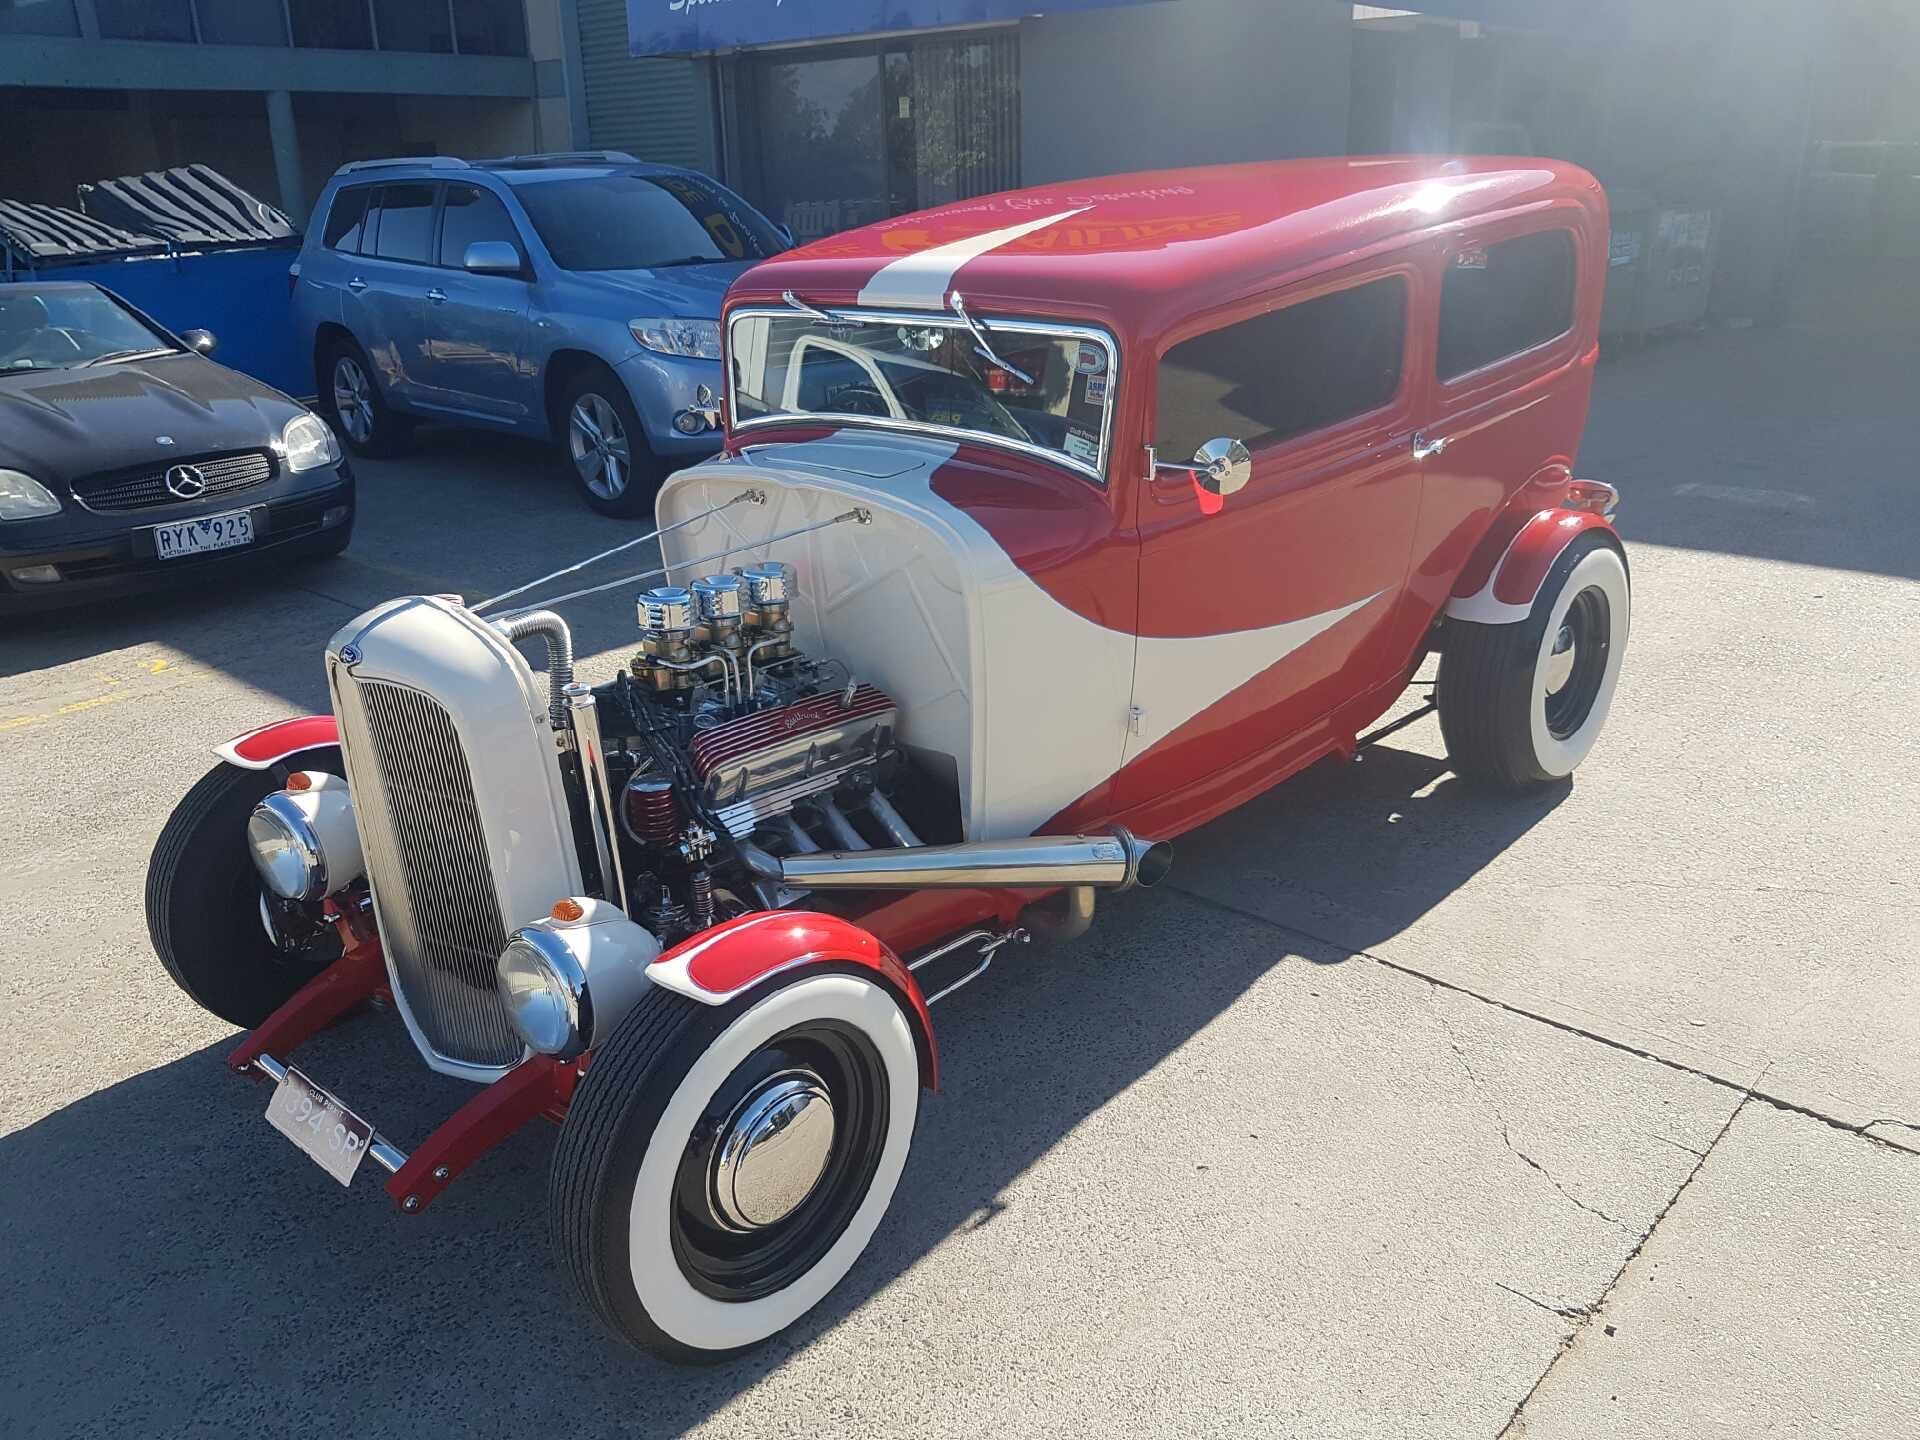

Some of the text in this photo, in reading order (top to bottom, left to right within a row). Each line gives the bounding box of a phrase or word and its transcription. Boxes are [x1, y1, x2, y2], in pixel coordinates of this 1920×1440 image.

[160, 517, 249, 550] RYK 925
[309, 1089, 344, 1118] CLUB PERMIT
